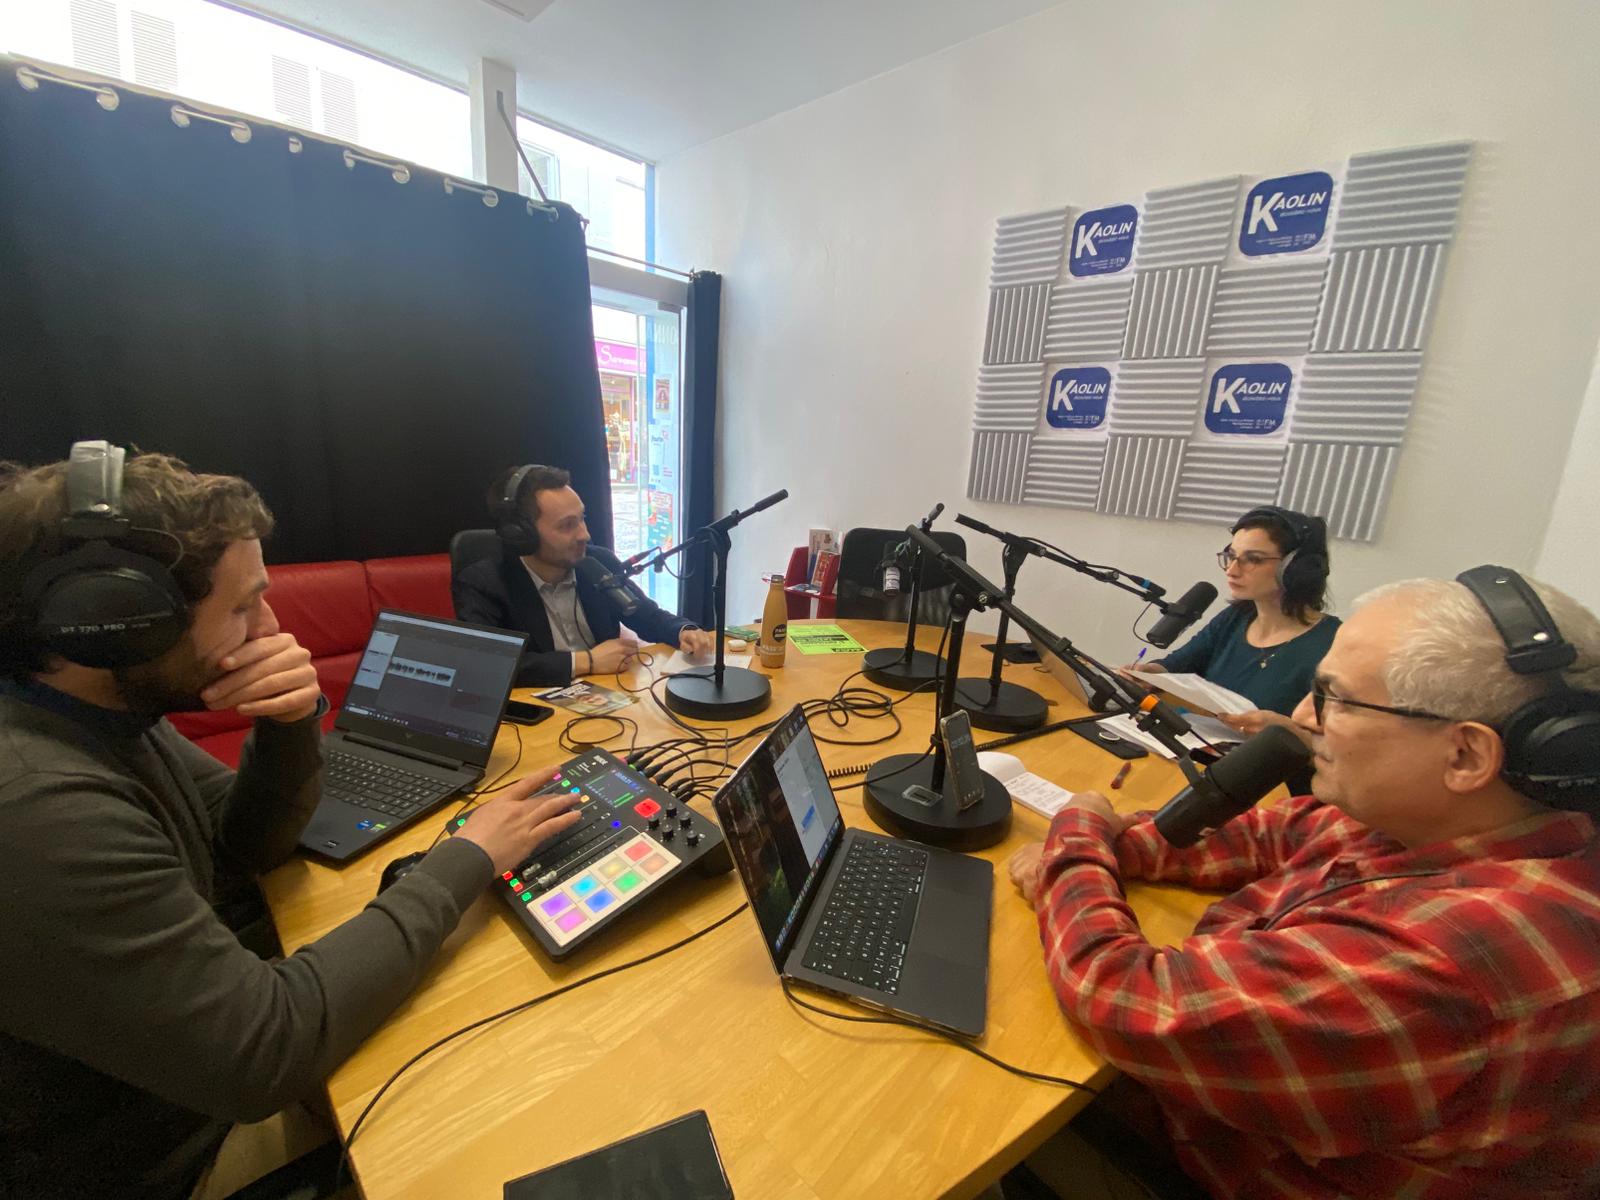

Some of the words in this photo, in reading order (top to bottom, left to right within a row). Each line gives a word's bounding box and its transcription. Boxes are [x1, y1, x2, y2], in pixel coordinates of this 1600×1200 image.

[1248, 191, 1327, 235] KAOLIN
[1075, 222, 1133, 259] KAOLIN
[1052, 379, 1107, 412] KAOLIN
[1213, 377, 1286, 414] KAOLIN
[103, 623, 126, 631] PRO
